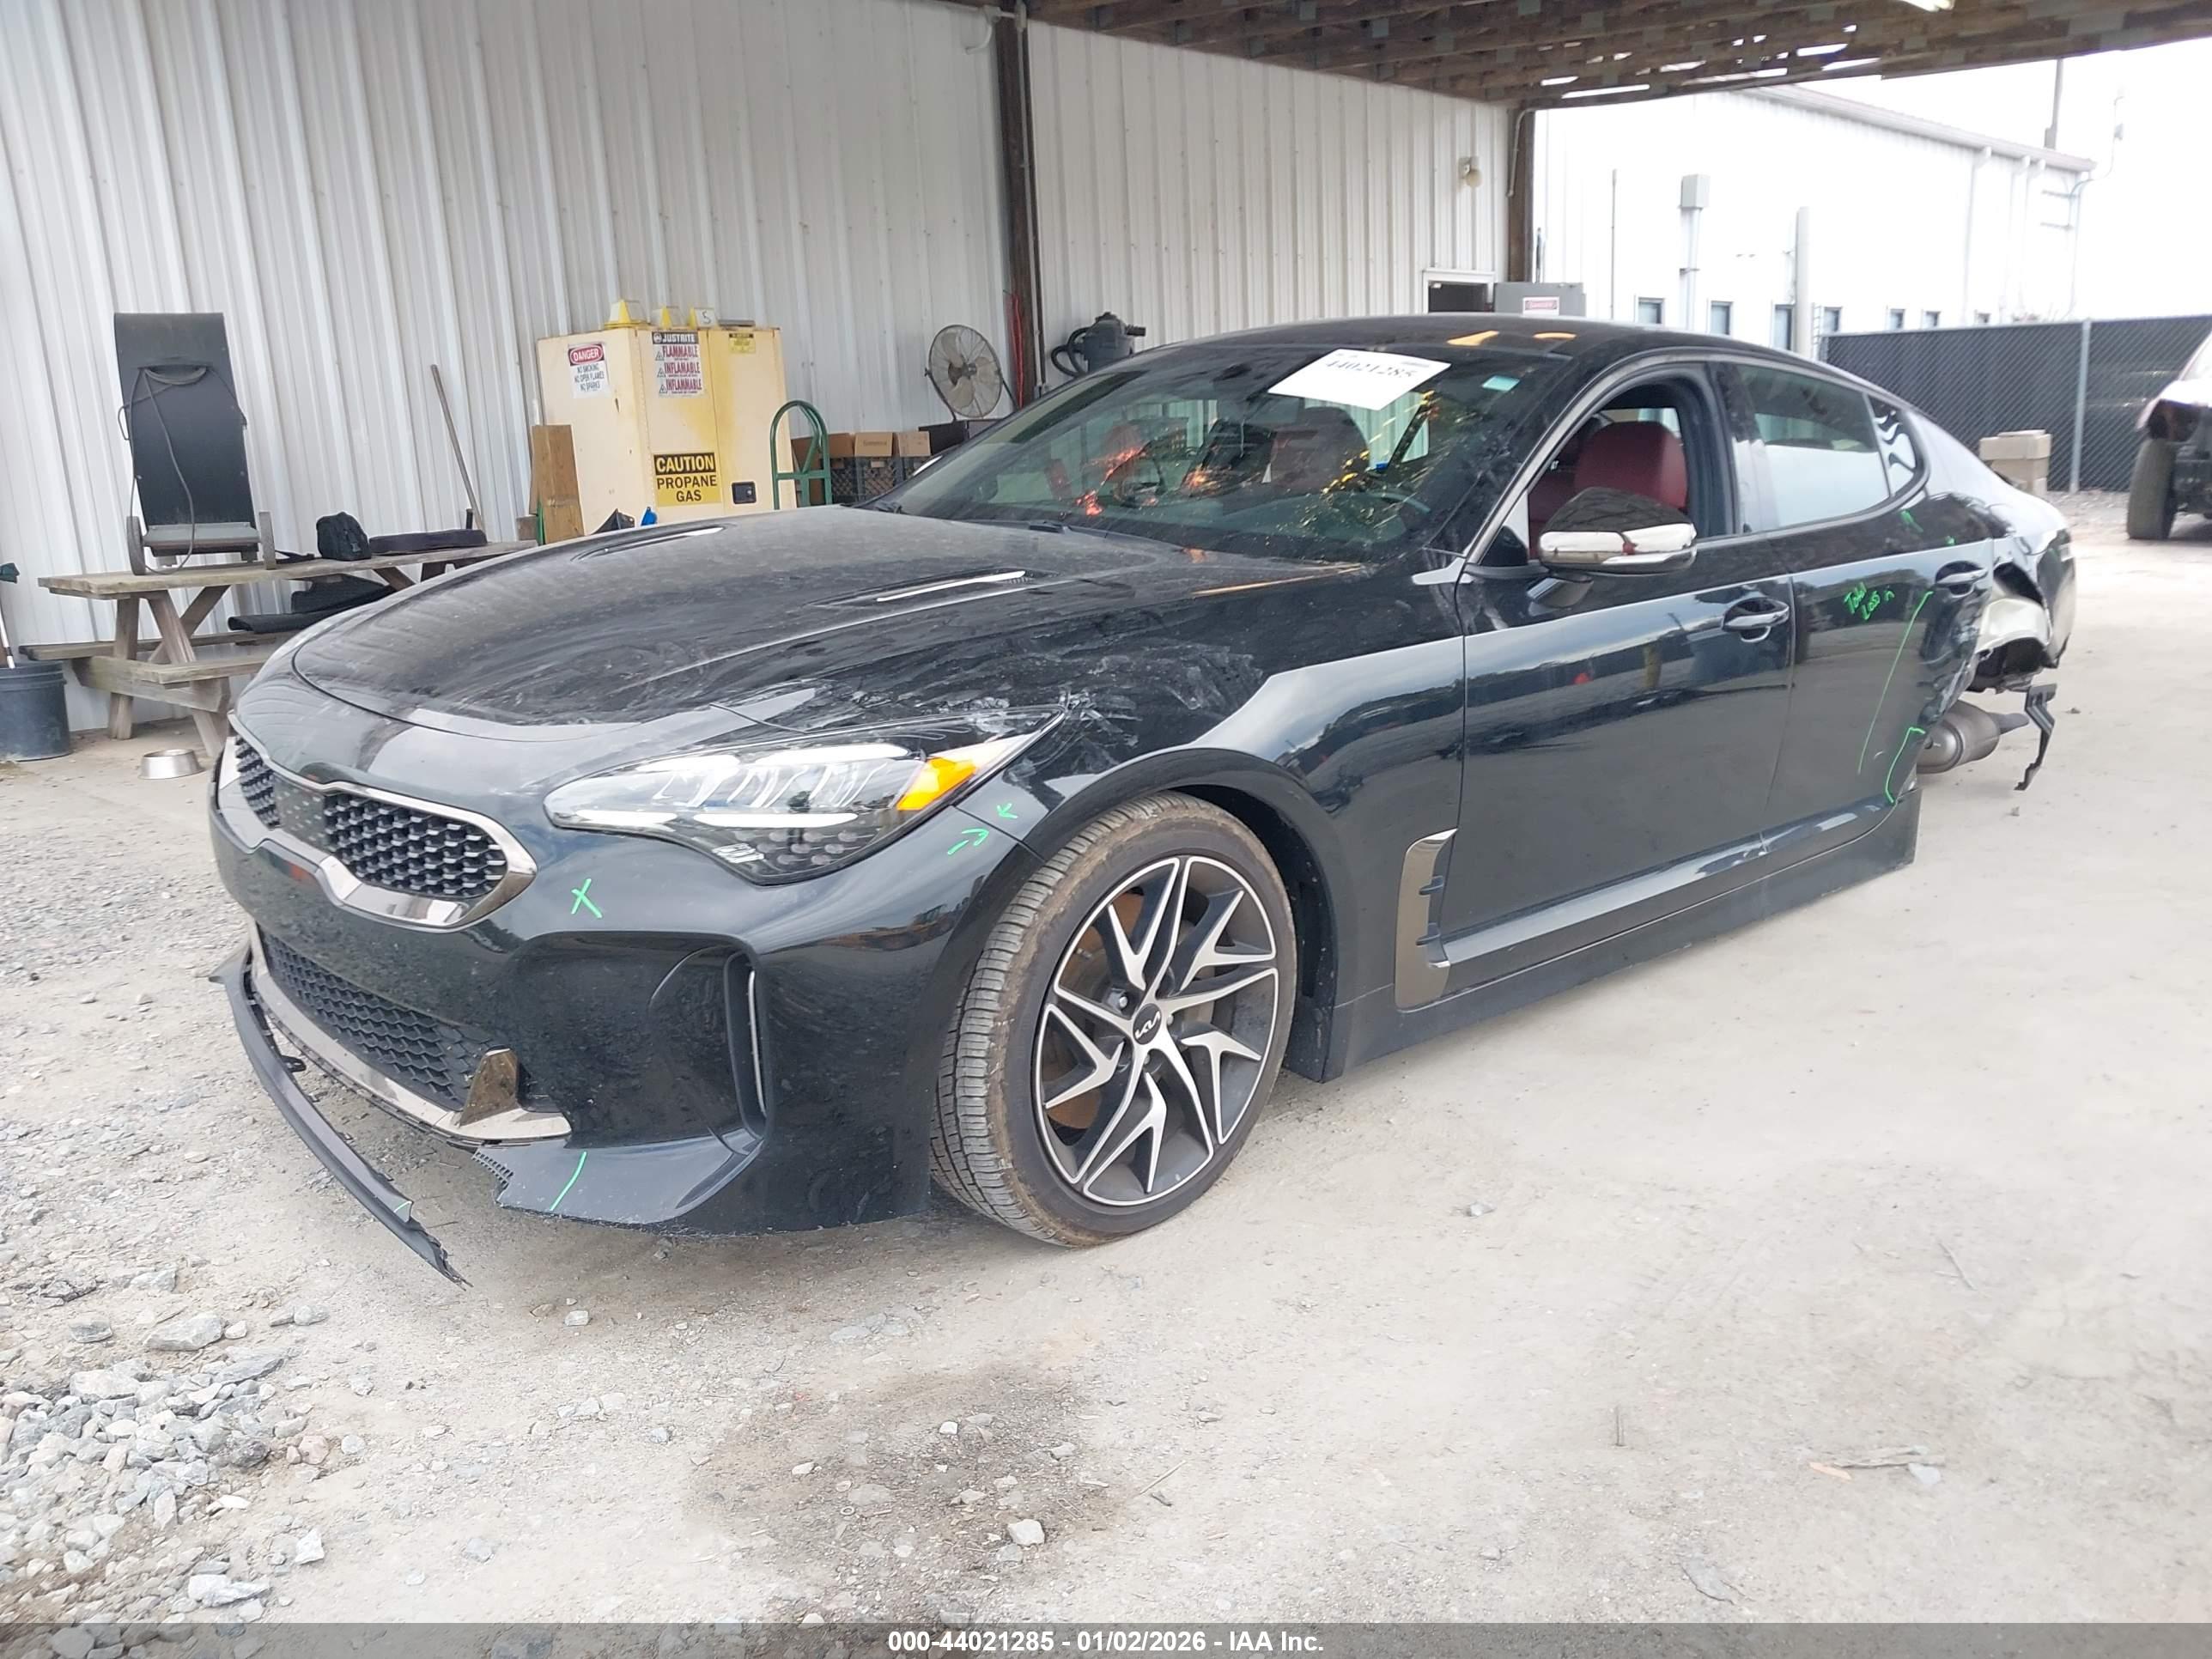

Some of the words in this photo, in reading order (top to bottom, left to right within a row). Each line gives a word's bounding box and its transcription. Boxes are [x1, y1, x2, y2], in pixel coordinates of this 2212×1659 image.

[662, 333, 696, 343] JUSTRITE
[573, 348, 600, 362] DANGER
[662, 345, 699, 358] FLAMMABLE
[656, 455, 714, 473] CAUTION
[657, 474, 718, 490] PROPANE
[676, 489, 702, 502] GAS
